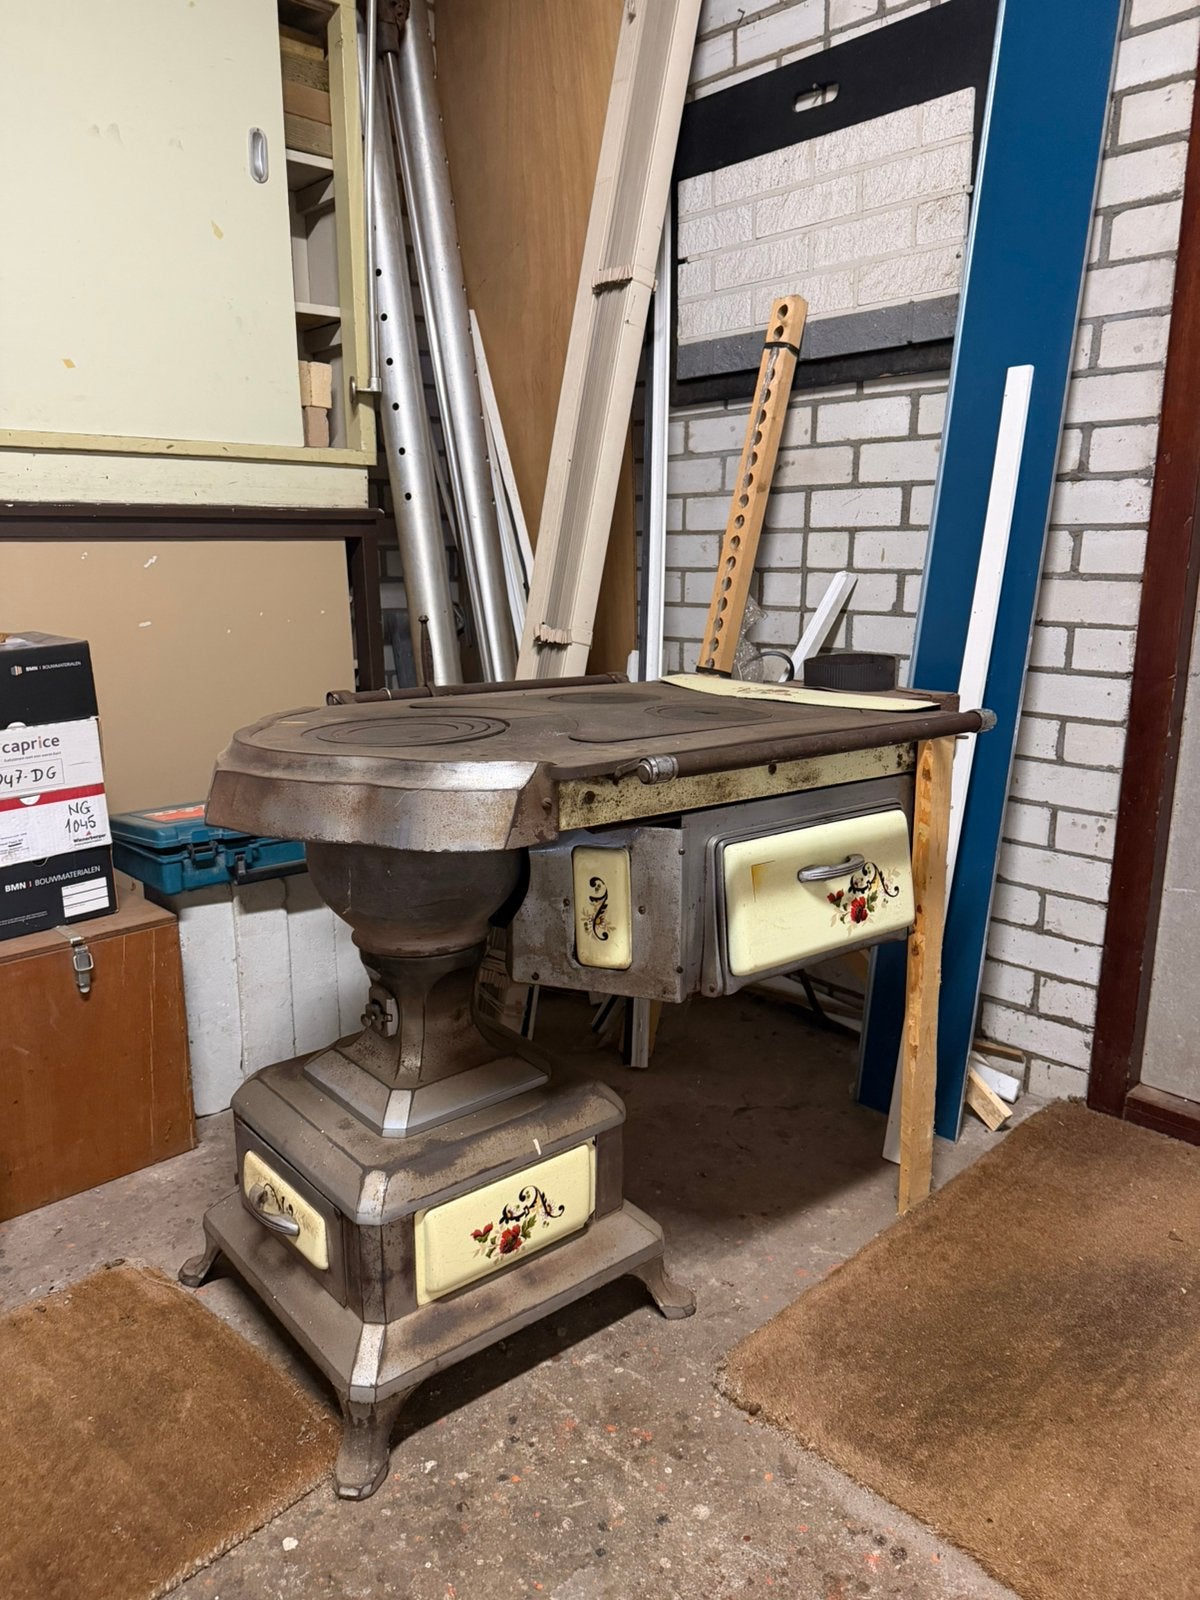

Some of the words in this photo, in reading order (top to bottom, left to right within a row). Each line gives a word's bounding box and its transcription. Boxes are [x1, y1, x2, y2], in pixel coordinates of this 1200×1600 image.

[2, 735, 60, 755] caprice
[68, 800, 91, 816] NG
[65, 814, 97, 833] 1045
[4, 881, 27, 893] BMN
[34, 865, 101, 887] BOUWMATERIALEN
